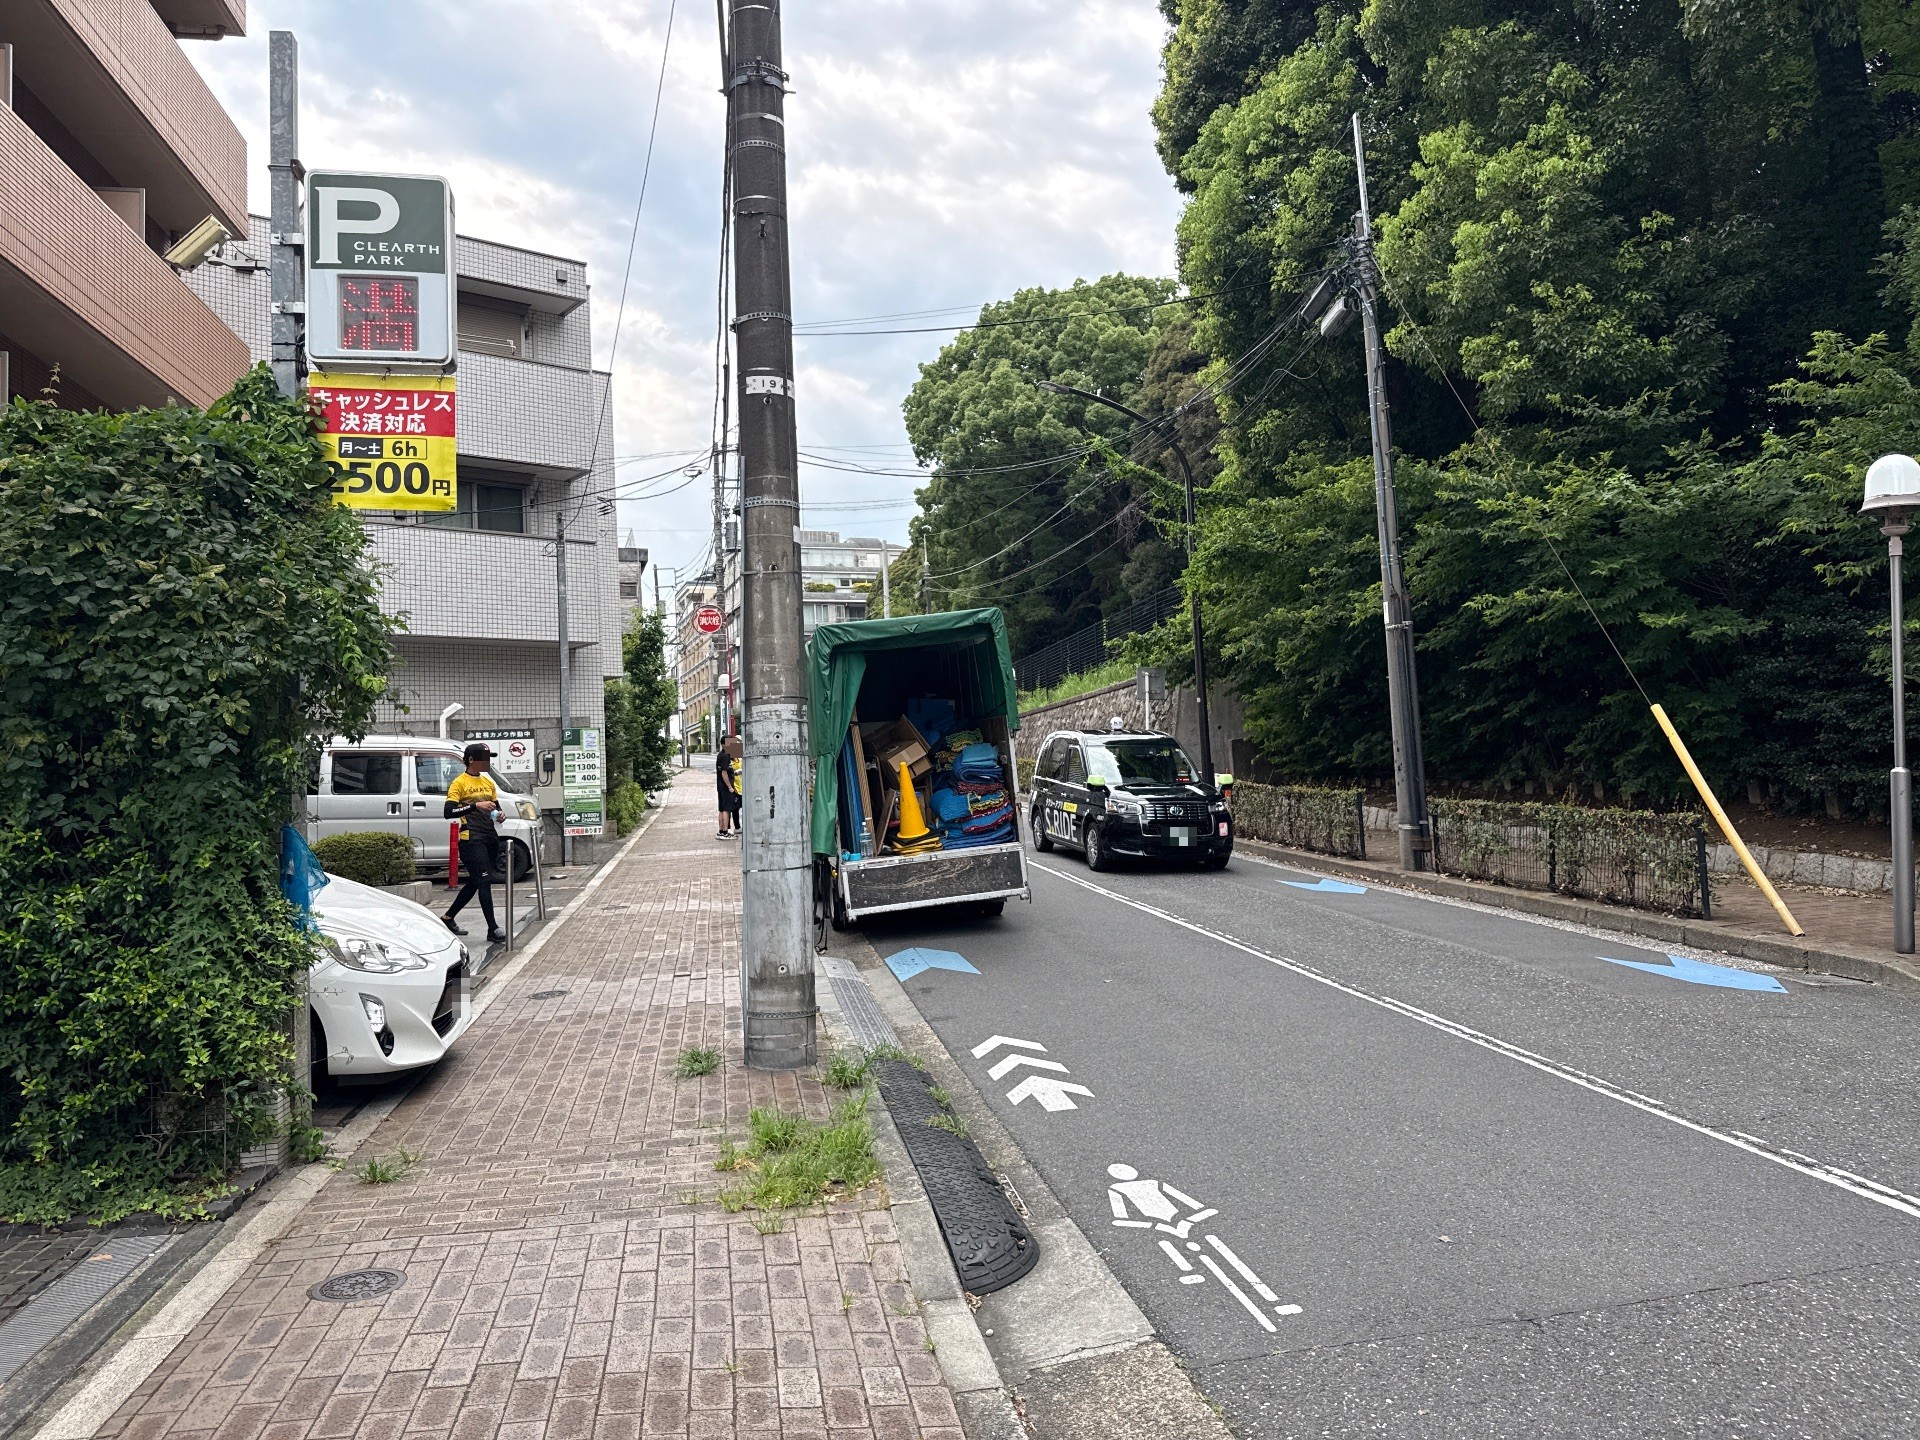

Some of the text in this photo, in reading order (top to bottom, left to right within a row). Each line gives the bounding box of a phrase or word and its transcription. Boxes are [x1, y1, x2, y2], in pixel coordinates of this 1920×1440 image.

[314, 186, 400, 264] P
[353, 241, 440, 255] CLEARTH
[354, 256, 405, 266] PARK
[343, 282, 417, 351] 満
[761, 379, 777, 388] 19
[314, 390, 452, 412] キャッシュレス
[340, 412, 426, 433] 決済対応
[392, 441, 418, 457] 6h
[699, 615, 720, 625] 消火栓
[475, 731, 531, 739] 監視カメラ作動中
